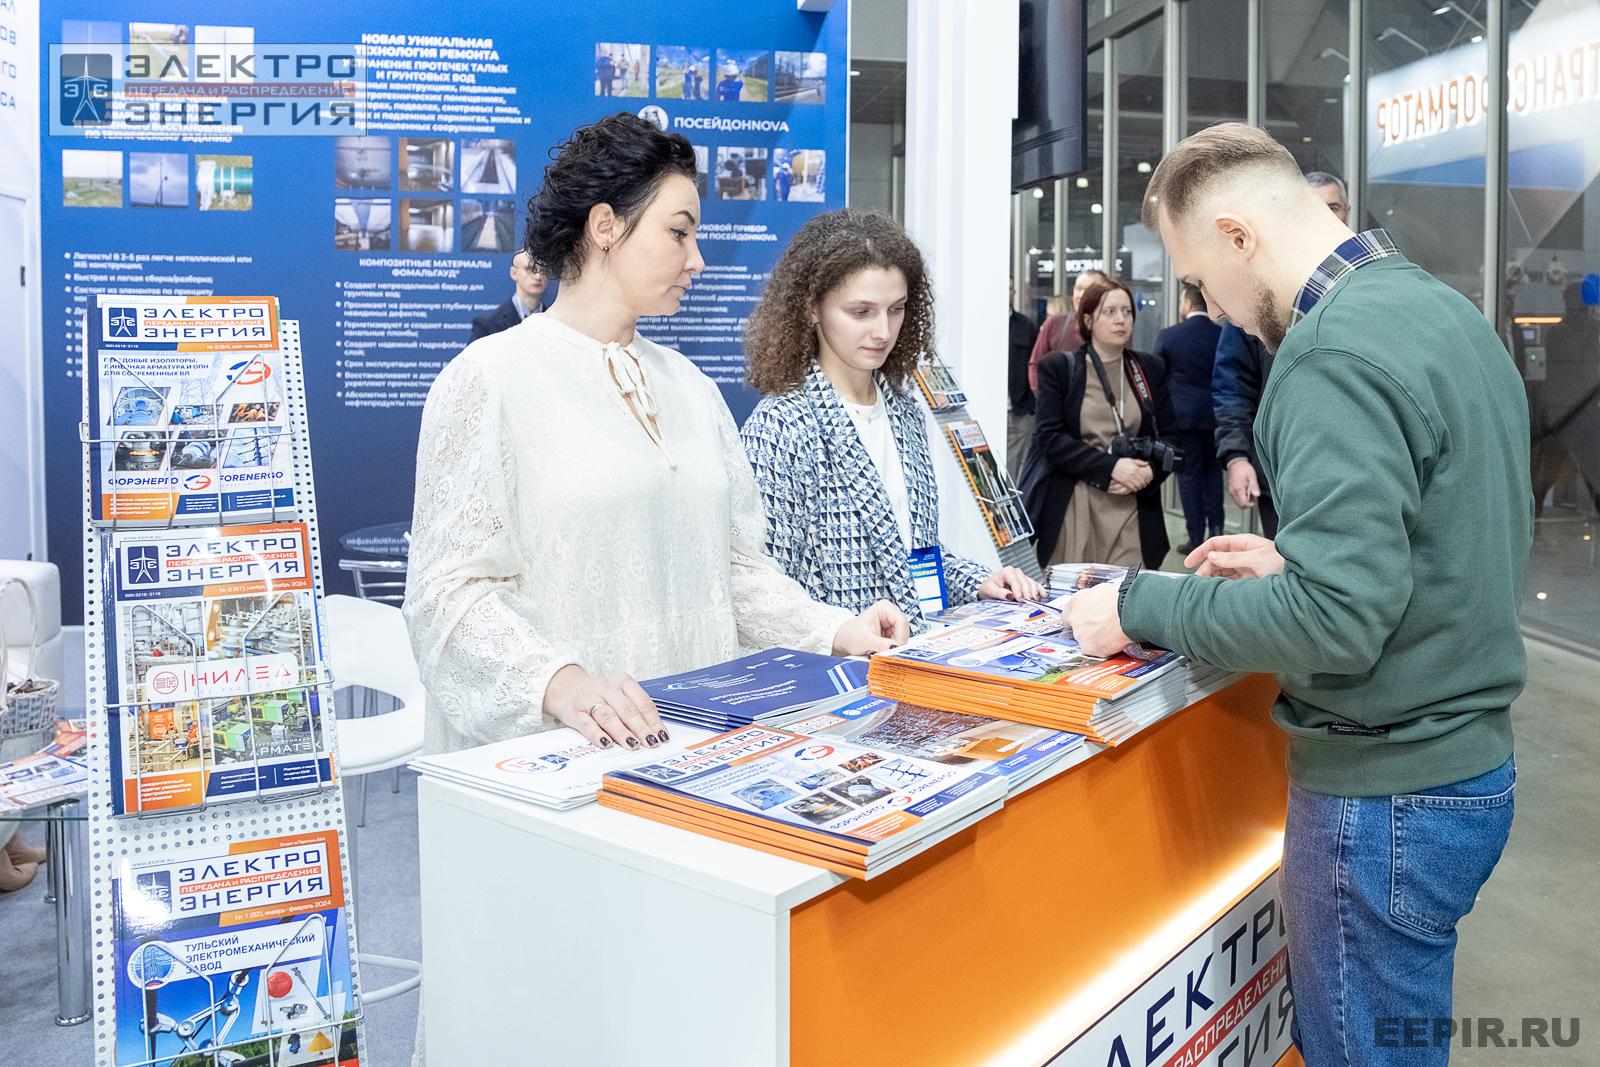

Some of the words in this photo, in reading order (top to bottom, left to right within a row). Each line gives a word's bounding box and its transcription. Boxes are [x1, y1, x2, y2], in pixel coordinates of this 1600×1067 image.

[362, 33, 406, 45] НОВАЯ
[408, 35, 493, 49] УНИКАЛЬНАЯ
[354, 45, 438, 59] ТЕХНОЛОГИЯ
[440, 47, 500, 61] РЕМОНТА
[342, 59, 412, 70] УСТРАНЕНИЕ
[415, 61, 470, 72] ПРОТЕЧЕК
[471, 63, 508, 73] ТАЛЫХ
[387, 72, 450, 82] ГРУНТОВЫХ
[452, 74, 476, 84] ВОД
[674, 117, 790, 133] ПОСЕЙДОНNOVA
[359, 258, 432, 268] КОМПОЗИТНЫЕ
[433, 259, 492, 269] МАТЕРИАЛЫ
[144, 308, 264, 318] ЭЛЕКТРО
[144, 327, 266, 338] ЭНЕРГИЯ
[108, 477, 178, 486] ФОРЭНЕРГО
[219, 471, 284, 482] FORENERGO
[166, 538, 296, 557] ЭЛЕКТРО
[167, 560, 298, 582] ЭНЕРГИЯ
[192, 664, 292, 687] НИЛЕД
[661, 729, 766, 766] ЭЛЕКТРО
[684, 734, 787, 773] ЭНЕРГИЯ
[179, 850, 320, 882] ЭЛЕКТРО
[180, 880, 230, 894] ПЕРЕДАЧА
[240, 868, 318, 884] РАСПРЕДЕЛЕНИЕ
[180, 877, 323, 912] ЭНЕРГИЯ
[314, 900, 332, 908] 2024
[185, 935, 239, 952] ТУЛЬСКИЙ
[186, 961, 222, 974] ЗАВОД
